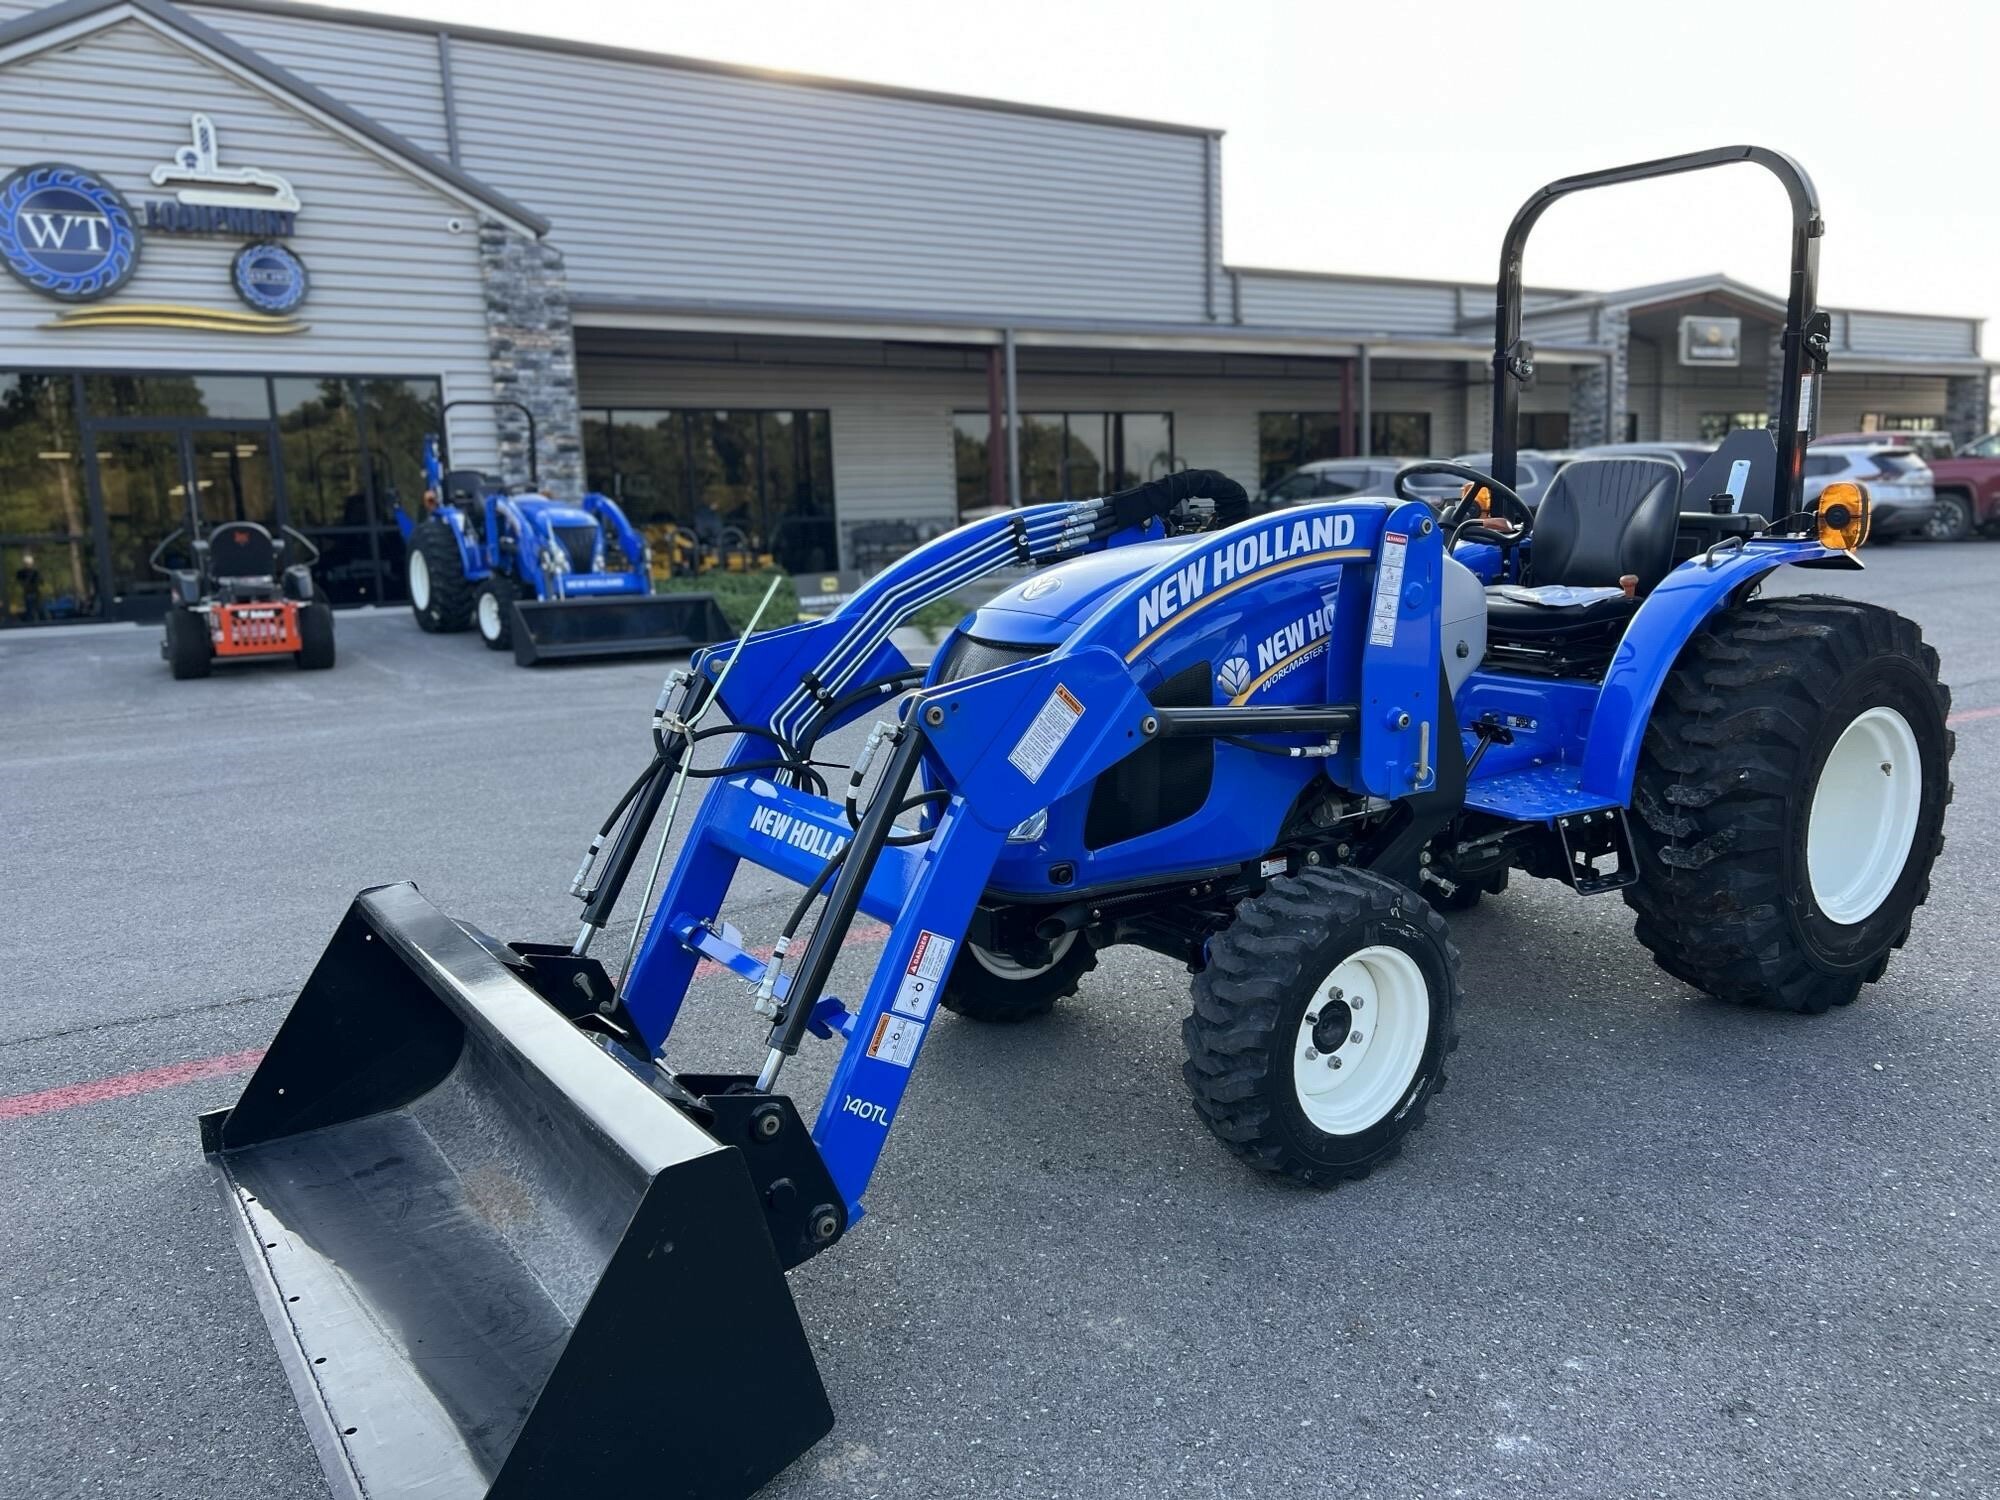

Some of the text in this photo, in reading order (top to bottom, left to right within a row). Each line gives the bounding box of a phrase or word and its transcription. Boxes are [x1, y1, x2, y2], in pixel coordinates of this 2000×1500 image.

[20, 212, 110, 251] WT
[144, 201, 297, 237] EQUIPMENT
[1138, 514, 1355, 638] NEW HOLLAND
[1257, 618, 1305, 673] NEW
[1262, 645, 1324, 692] WORKMASTER
[750, 804, 850, 861] NEW HOLLA
[912, 933, 930, 965] DANGER
[842, 1095, 889, 1127] 140TL
